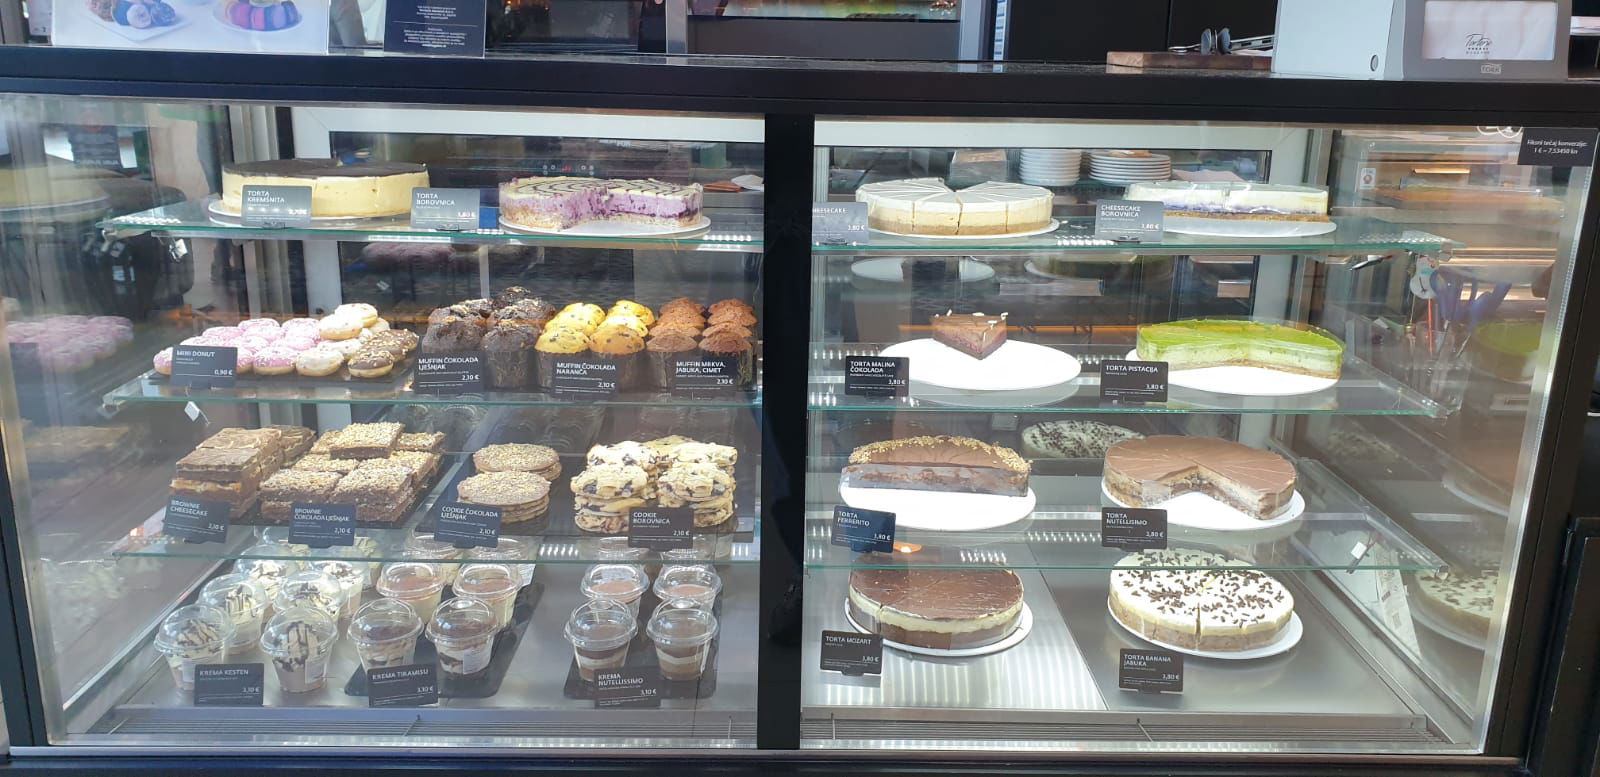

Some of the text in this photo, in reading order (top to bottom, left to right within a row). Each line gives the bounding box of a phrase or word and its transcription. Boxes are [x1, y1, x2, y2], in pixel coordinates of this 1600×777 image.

[171, 500, 201, 508] BROWNIE
[170, 506, 208, 516] CHEESECAKE
[465, 508, 498, 517] ČOKOLADA
[440, 512, 467, 520] LJEŠNJAK
[837, 518, 870, 526] FERRERITO
[397, 668, 429, 678] TIRAMISU
[598, 673, 621, 681] KREMA
[598, 677, 644, 686] NUTELLISSIMO
